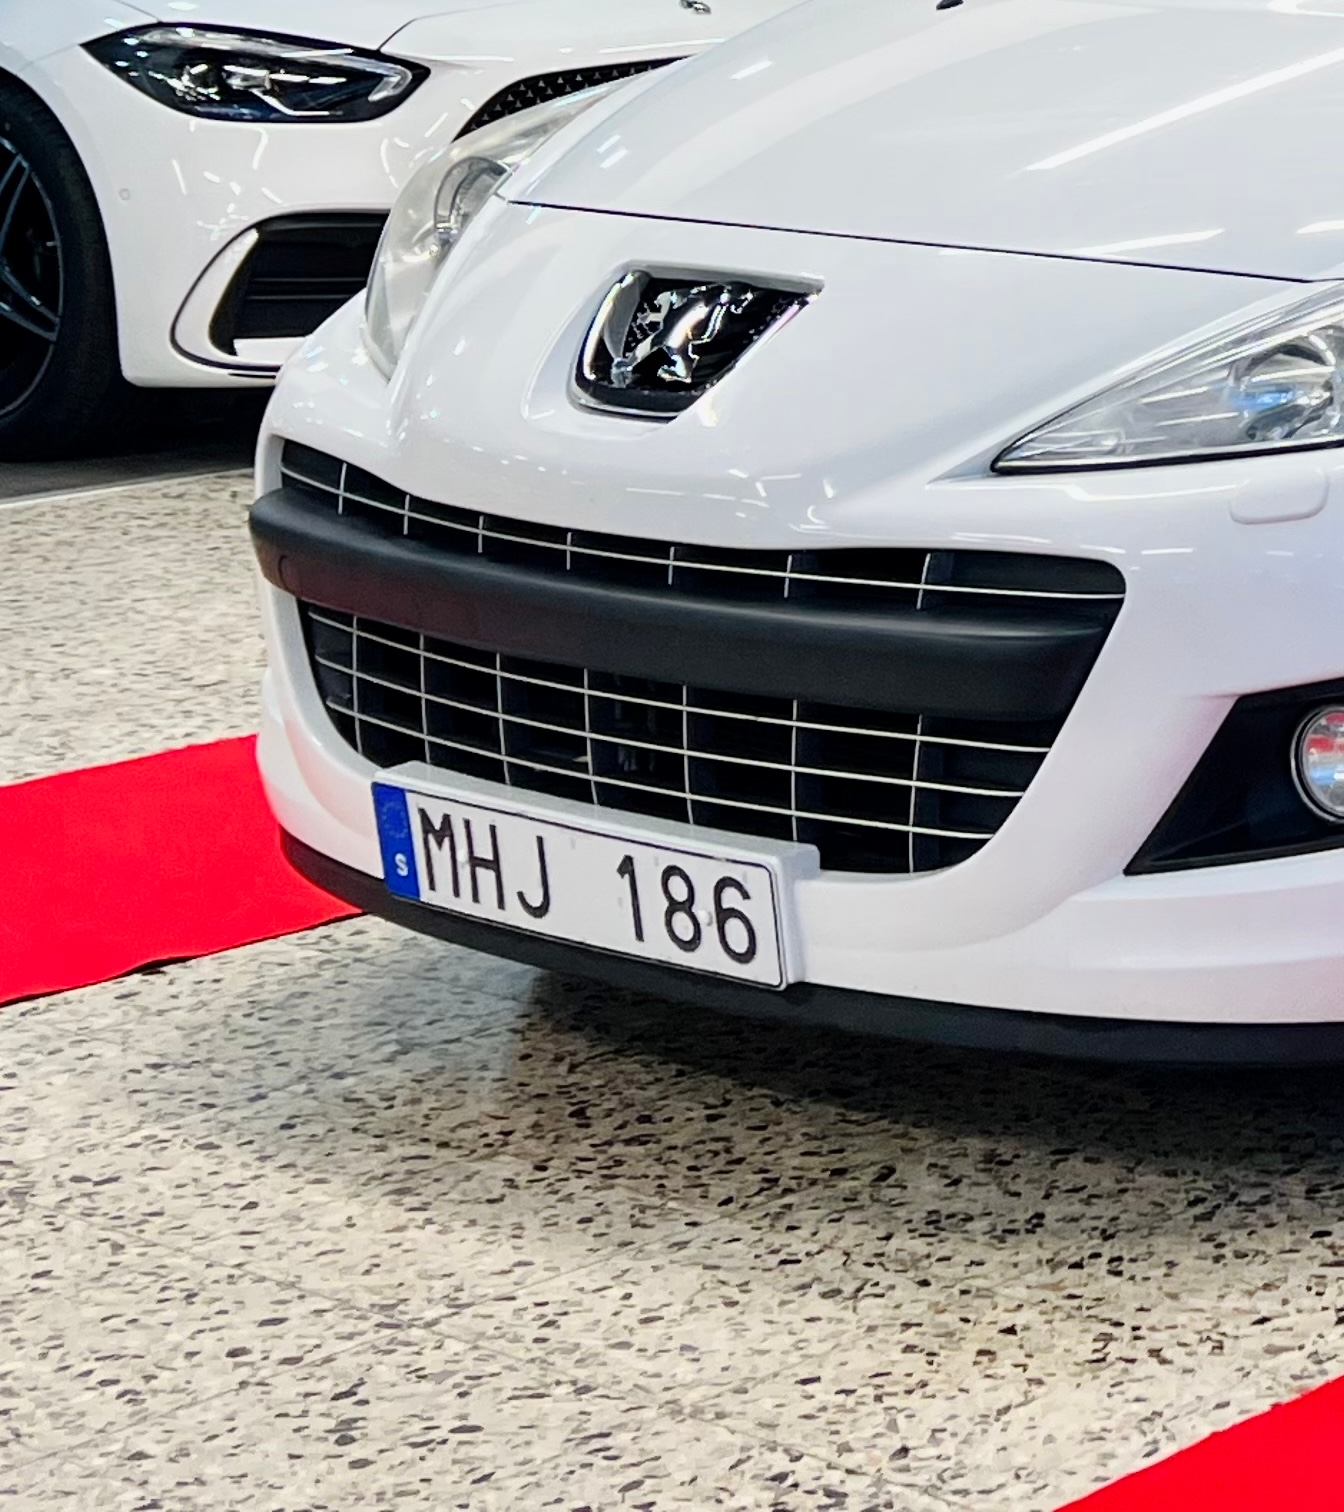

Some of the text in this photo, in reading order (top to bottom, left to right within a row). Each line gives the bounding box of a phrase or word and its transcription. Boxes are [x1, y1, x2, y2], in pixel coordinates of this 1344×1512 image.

[394, 853, 408, 877] S
[418, 807, 757, 964] MHJ 186
